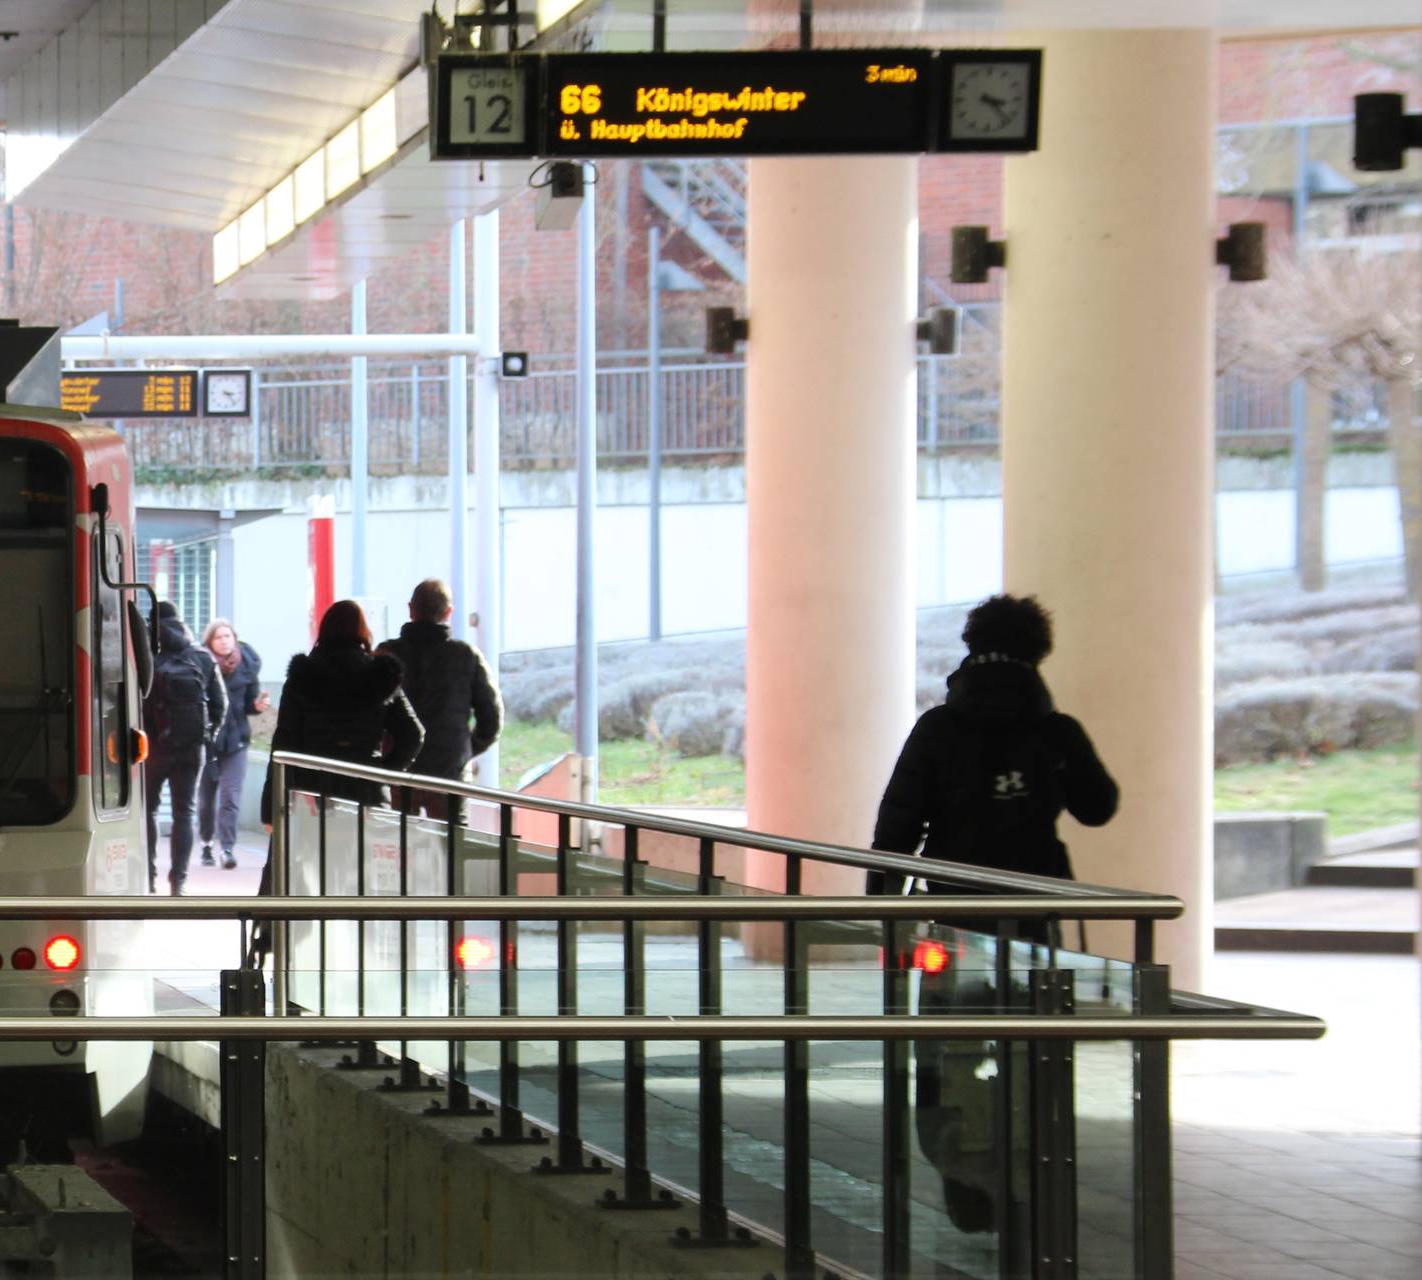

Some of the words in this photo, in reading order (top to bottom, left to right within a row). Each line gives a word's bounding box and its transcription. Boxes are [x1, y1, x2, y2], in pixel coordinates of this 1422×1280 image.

[866, 65, 880, 83] 3
[881, 65, 917, 82] min
[463, 94, 512, 135] 12
[560, 84, 601, 115] 66
[635, 87, 806, 117] Königswinter
[560, 119, 580, 140] ü.
[590, 118, 748, 143] Hauptbahnhof
